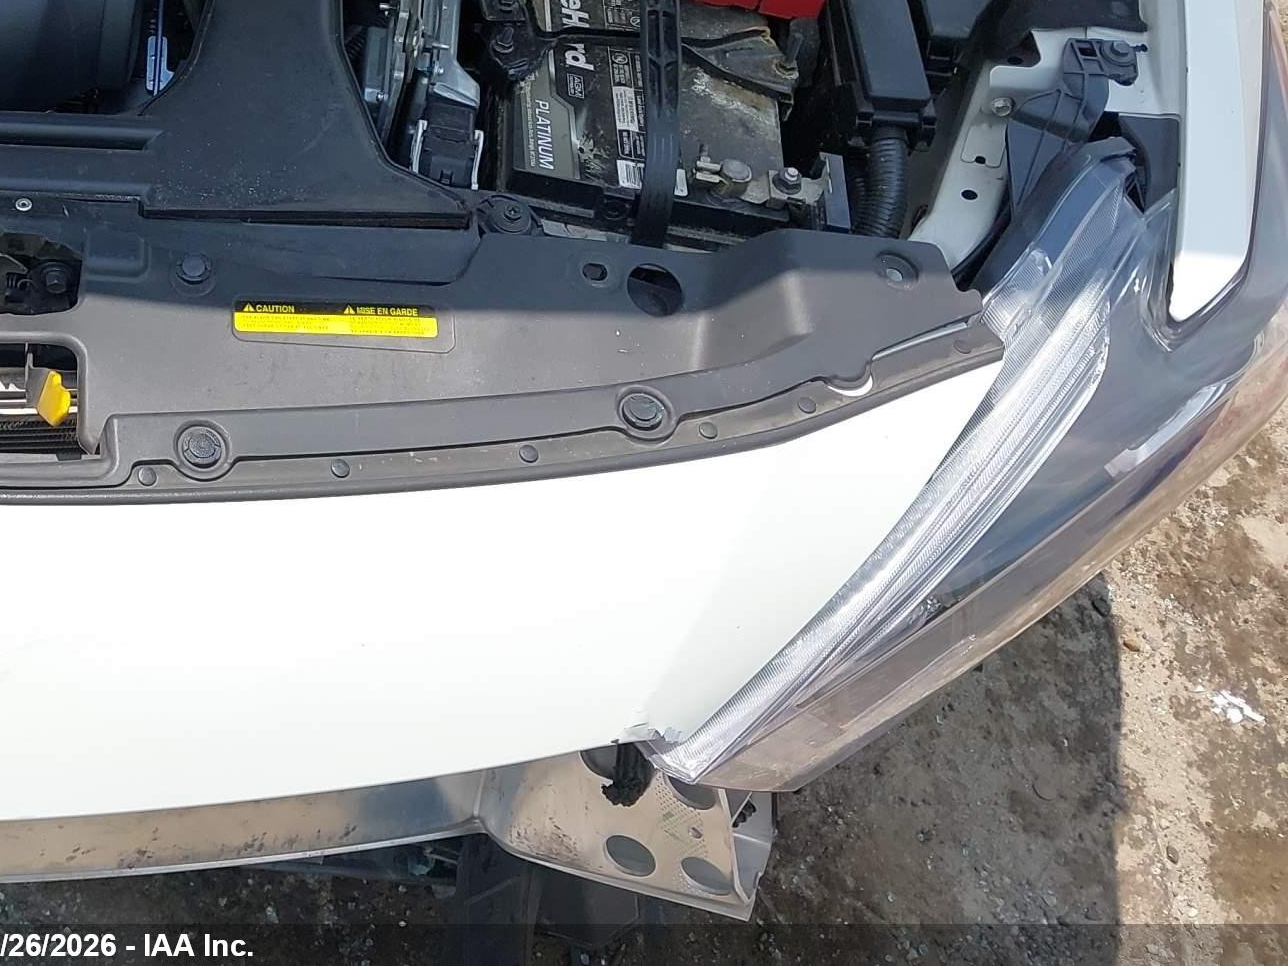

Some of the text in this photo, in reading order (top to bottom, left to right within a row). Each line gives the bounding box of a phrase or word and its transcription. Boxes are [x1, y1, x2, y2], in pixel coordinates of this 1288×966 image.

[535, 99, 555, 170] PLATINUM
[255, 304, 295, 314] CAUTION
[357, 306, 419, 317] MISE EN GARDE
